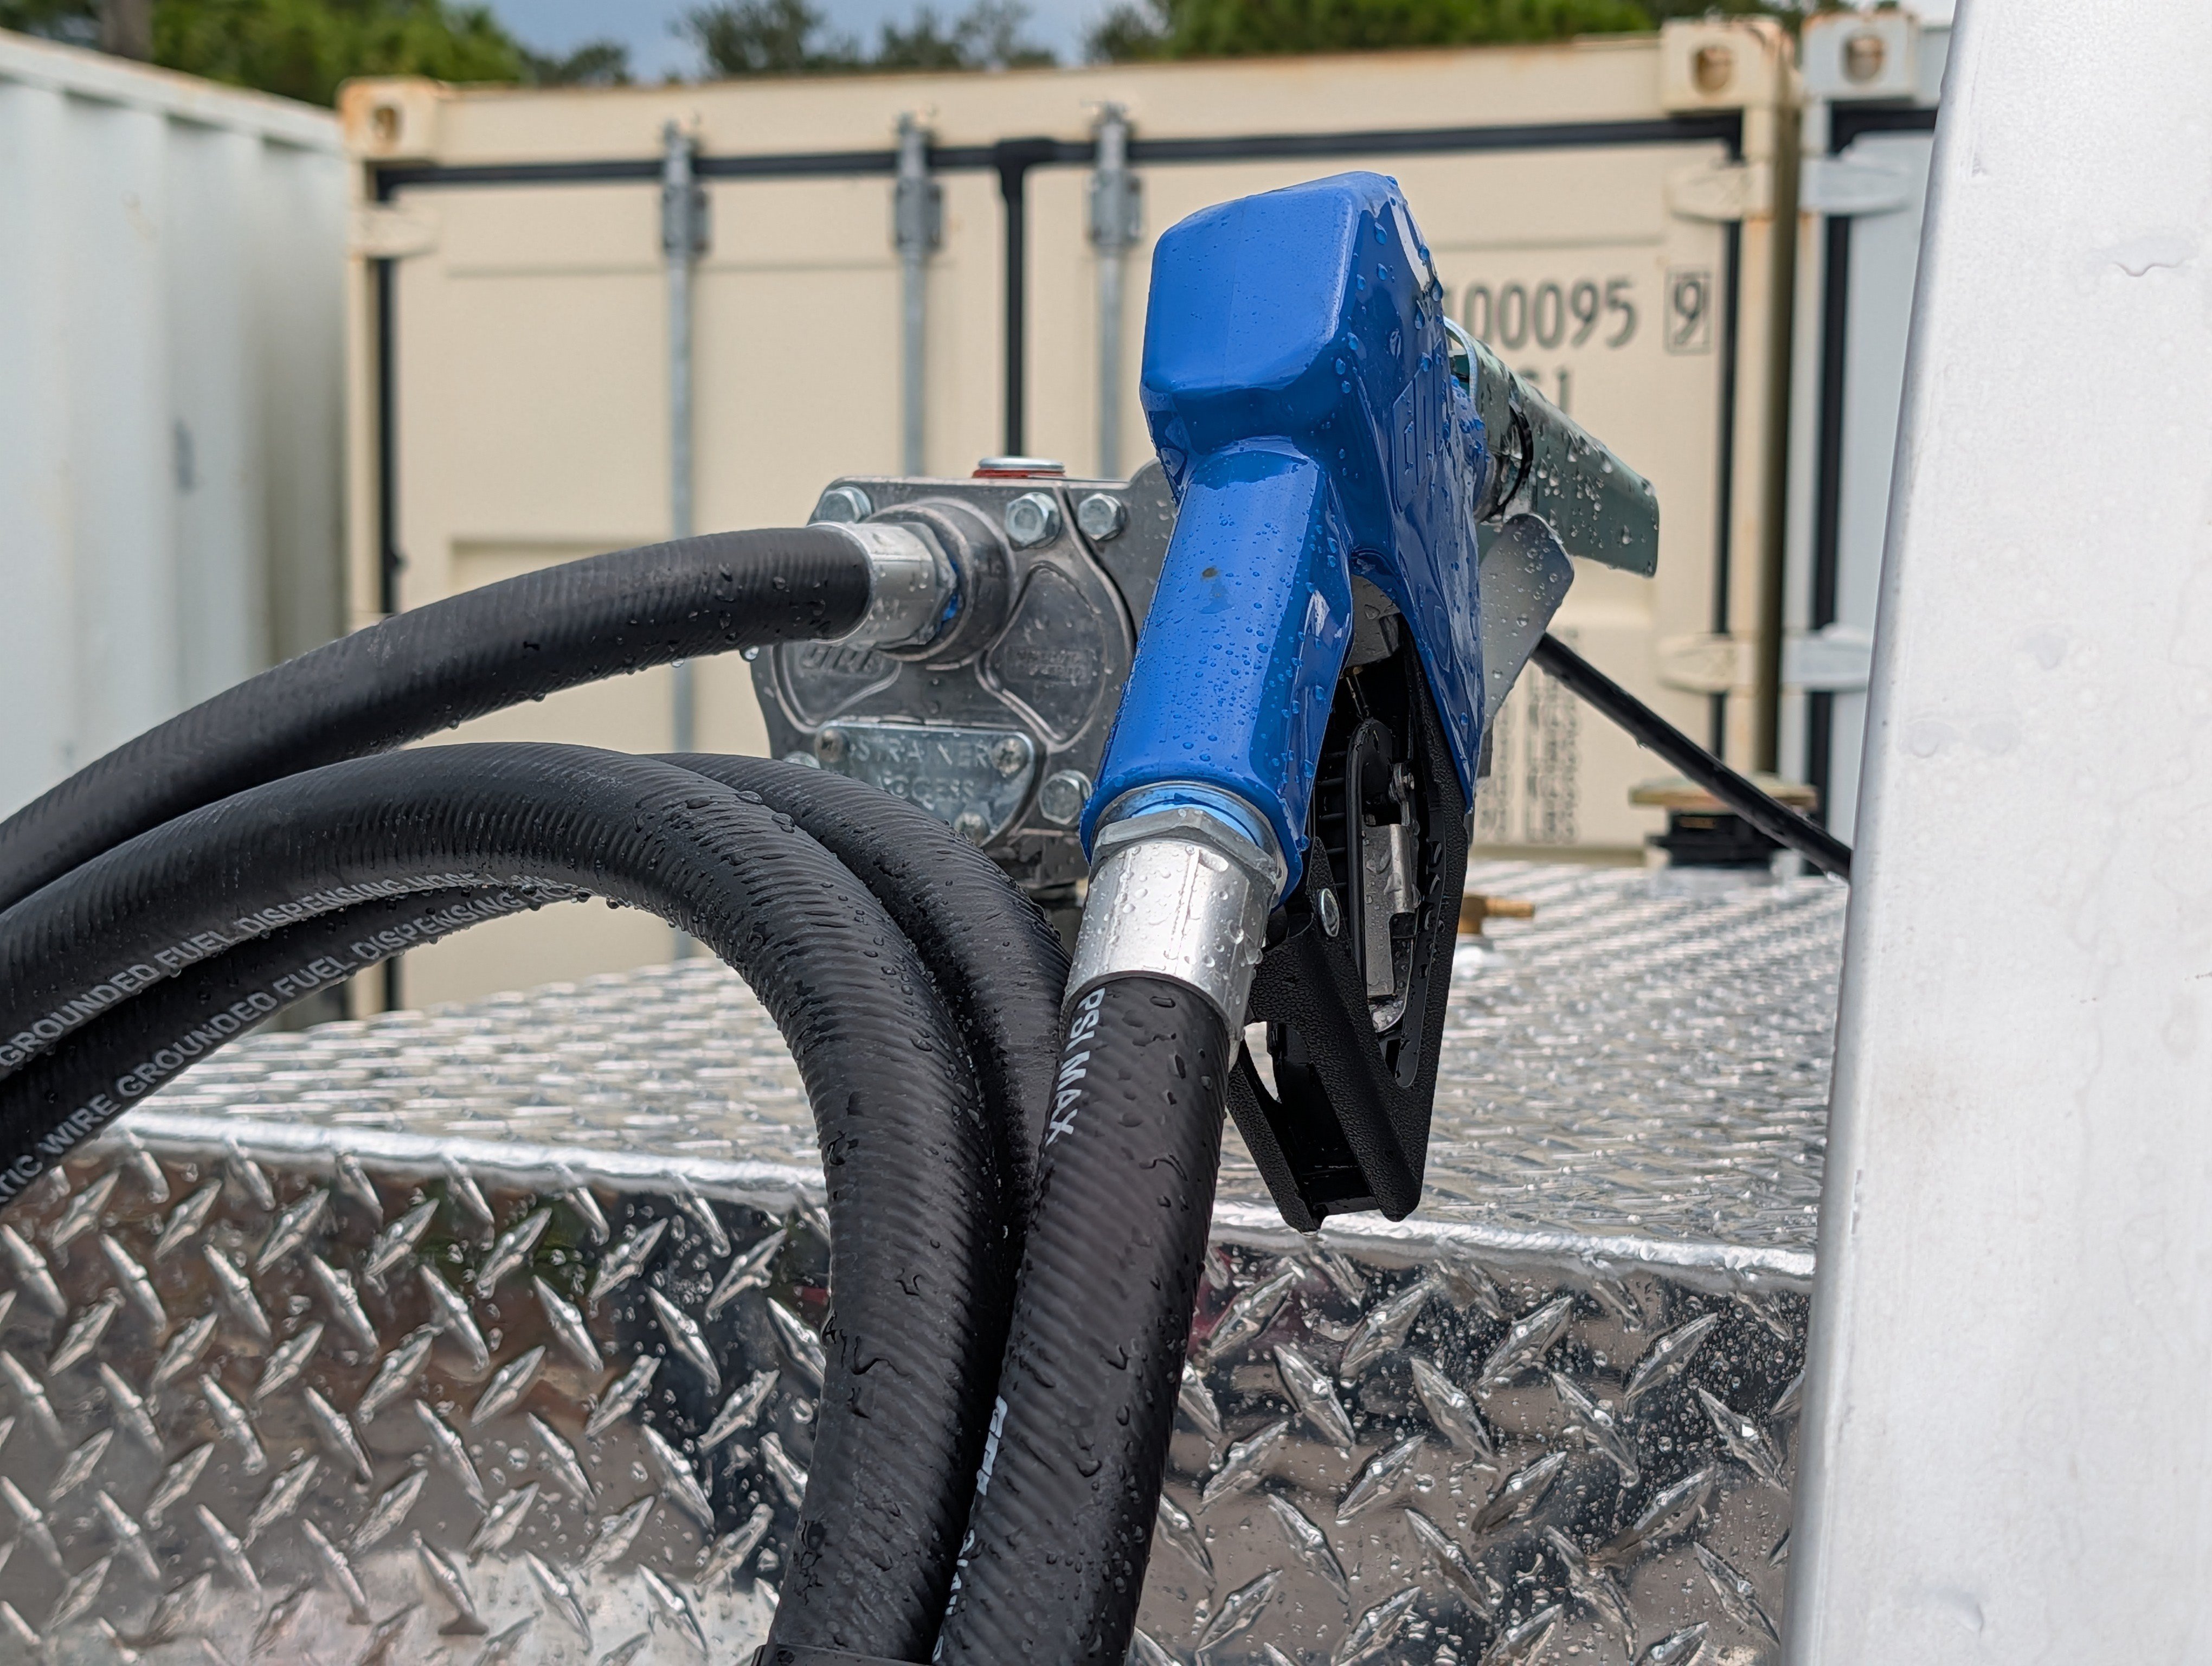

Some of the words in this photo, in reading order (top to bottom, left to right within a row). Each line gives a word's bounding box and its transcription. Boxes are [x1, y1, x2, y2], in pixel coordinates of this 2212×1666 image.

[1671, 277, 1705, 348] 9
[0, 964, 159, 1066] GROUNDED
[155, 931, 237, 969] FUEL
[234, 879, 409, 933] DISPENSING
[1064, 987, 1106, 1053] PSI
[0, 1155, 43, 1203] TIC
[36, 1093, 121, 1155] WIRE
[116, 990, 278, 1098] GROUNDED
[273, 955, 358, 998] FUEL
[350, 892, 528, 961] DISPENSING
[1045, 1050, 1091, 1146] MAX
